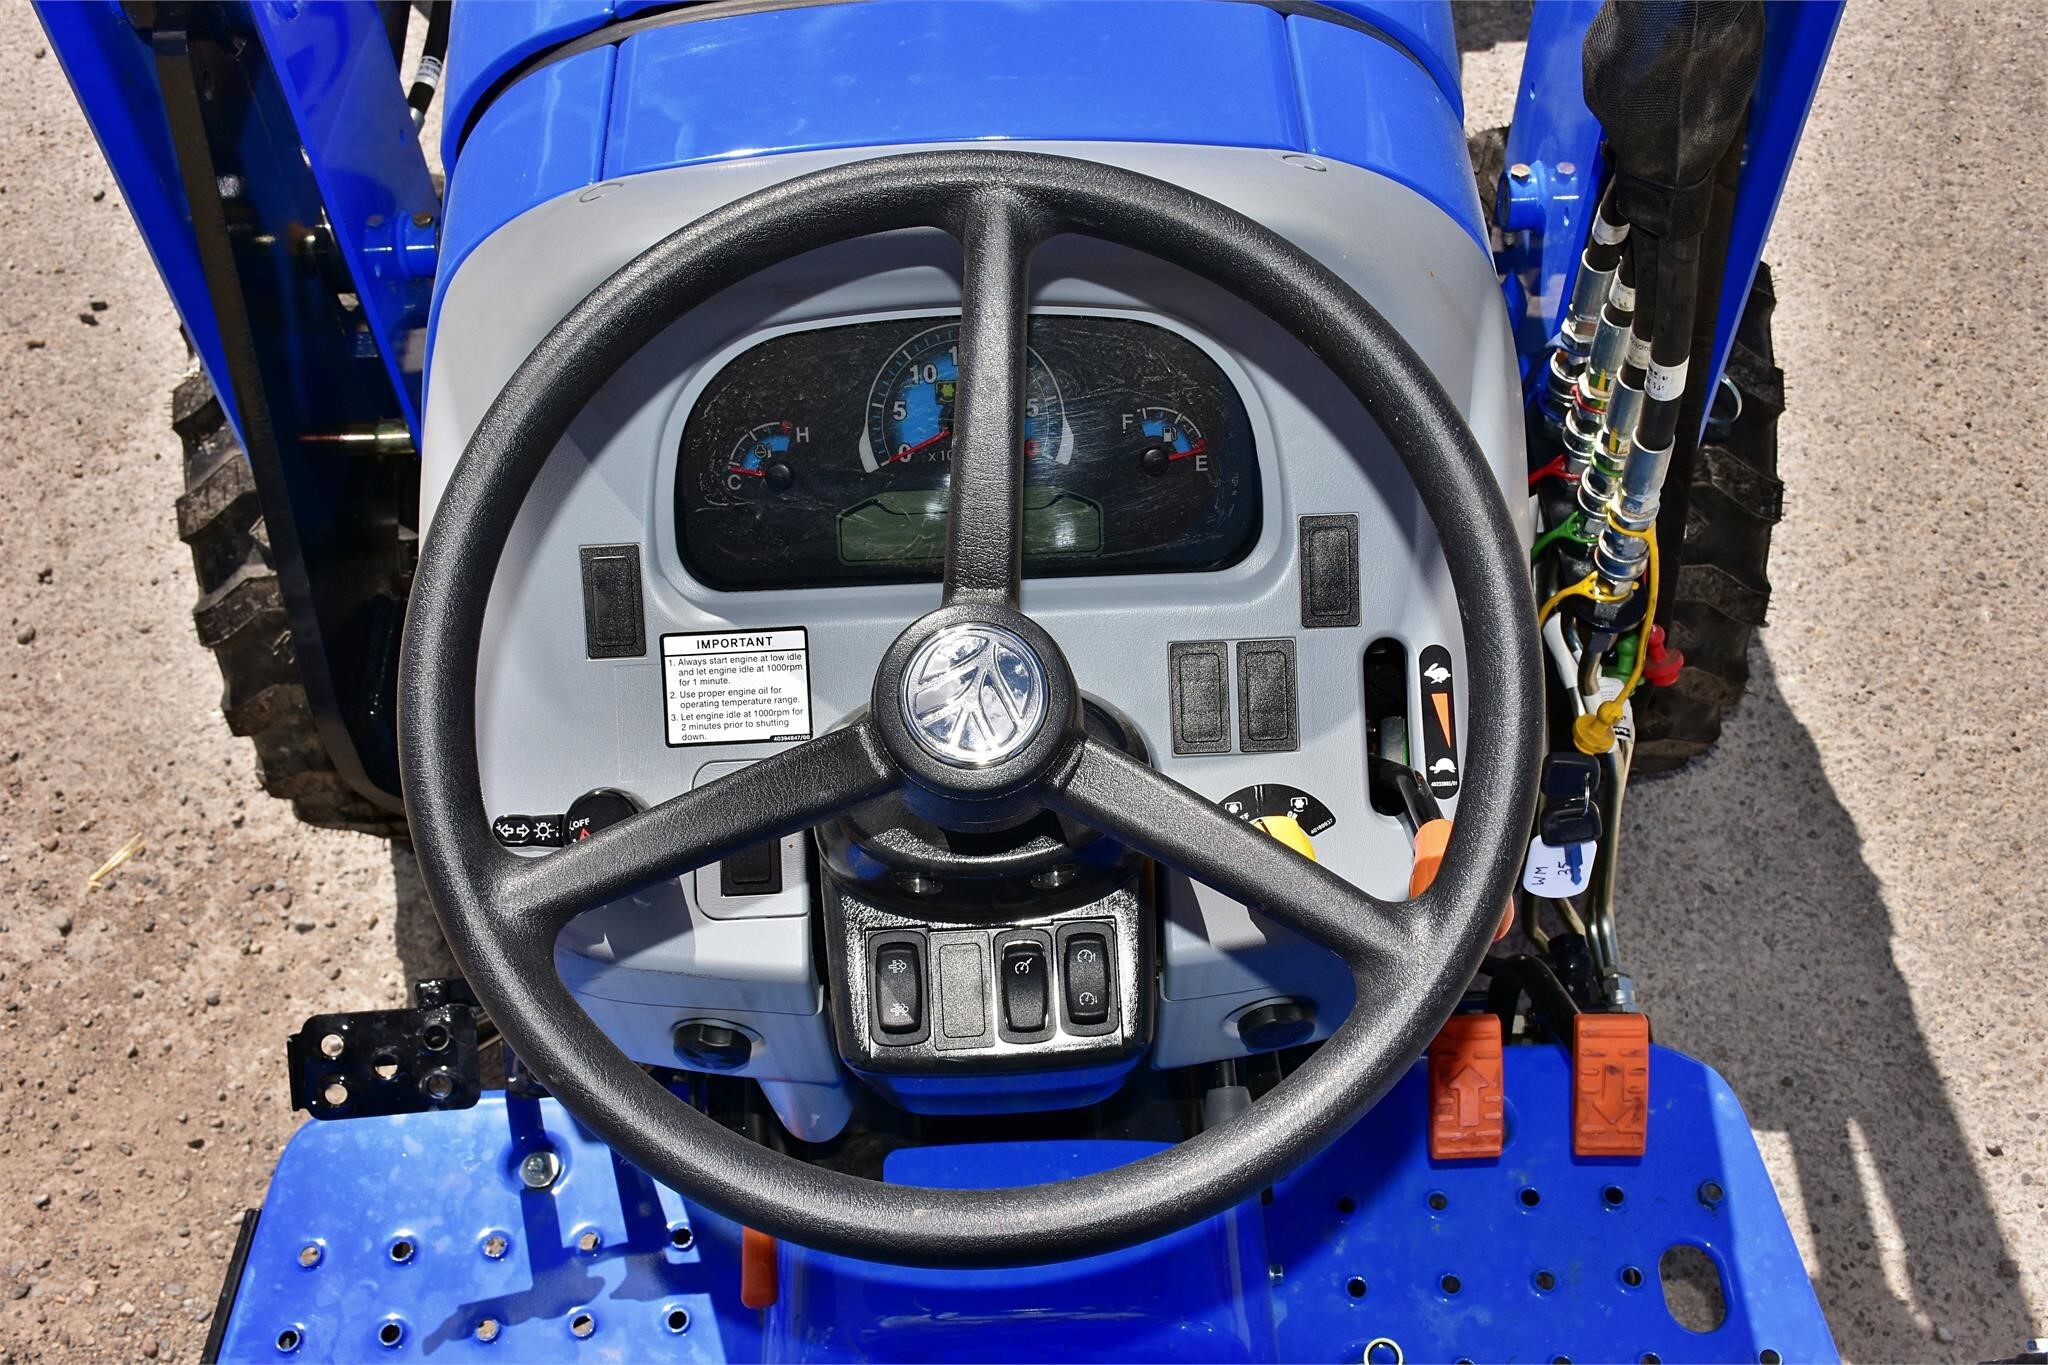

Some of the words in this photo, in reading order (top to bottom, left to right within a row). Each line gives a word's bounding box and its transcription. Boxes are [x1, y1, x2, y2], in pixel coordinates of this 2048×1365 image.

[910, 364, 937, 384] 10
[893, 401, 907, 420] 5
[1122, 413, 1133, 430] F
[796, 427, 809, 443] H
[899, 443, 912, 463] 0
[1196, 455, 1208, 471] E
[728, 474, 741, 490] C
[696, 636, 774, 650] IMPORTANT
[669, 659, 676, 667] 1.
[678, 657, 707, 667] Always
[709, 656, 728, 665] start
[730, 655, 758, 666] engine
[770, 653, 785, 662] low
[787, 652, 802, 661] idle
[678, 667, 695, 677] and
[696, 667, 707, 675] let
[709, 666, 737, 677] engine
[739, 665, 754, 674] idle
[756, 664, 765, 673] at
[767, 662, 803, 673] 1000rpm
[679, 678, 690, 687] for
[692, 678, 697, 686] 1
[700, 677, 731, 685] minute.
[669, 690, 677, 699] 2.
[679, 690, 696, 699] Use
[698, 689, 726, 700] proper
[728, 687, 756, 698] engine
[758, 686, 769, 695] oil
[770, 685, 782, 694] for
[680, 699, 720, 711] operating
[721, 697, 772, 708] temperature
[774, 696, 801, 706] range.
[670, 713, 679, 722] 3.
[680, 713, 694, 721] Let
[695, 711, 724, 722] engine
[725, 710, 741, 719] idle
[743, 710, 752, 718] at
[754, 708, 790, 718] 1000rpm
[792, 707, 804, 715] for
[681, 723, 687, 731] 2
[688, 721, 722, 731] minutes
[723, 720, 743, 731] prior
[745, 720, 754, 728] to
[755, 718, 790, 728] shutting
[681, 733, 708, 741] down.
[572, 817, 590, 828] OFF
[1287, 810, 1298, 820] ON
[1531, 866, 1549, 886] WM
